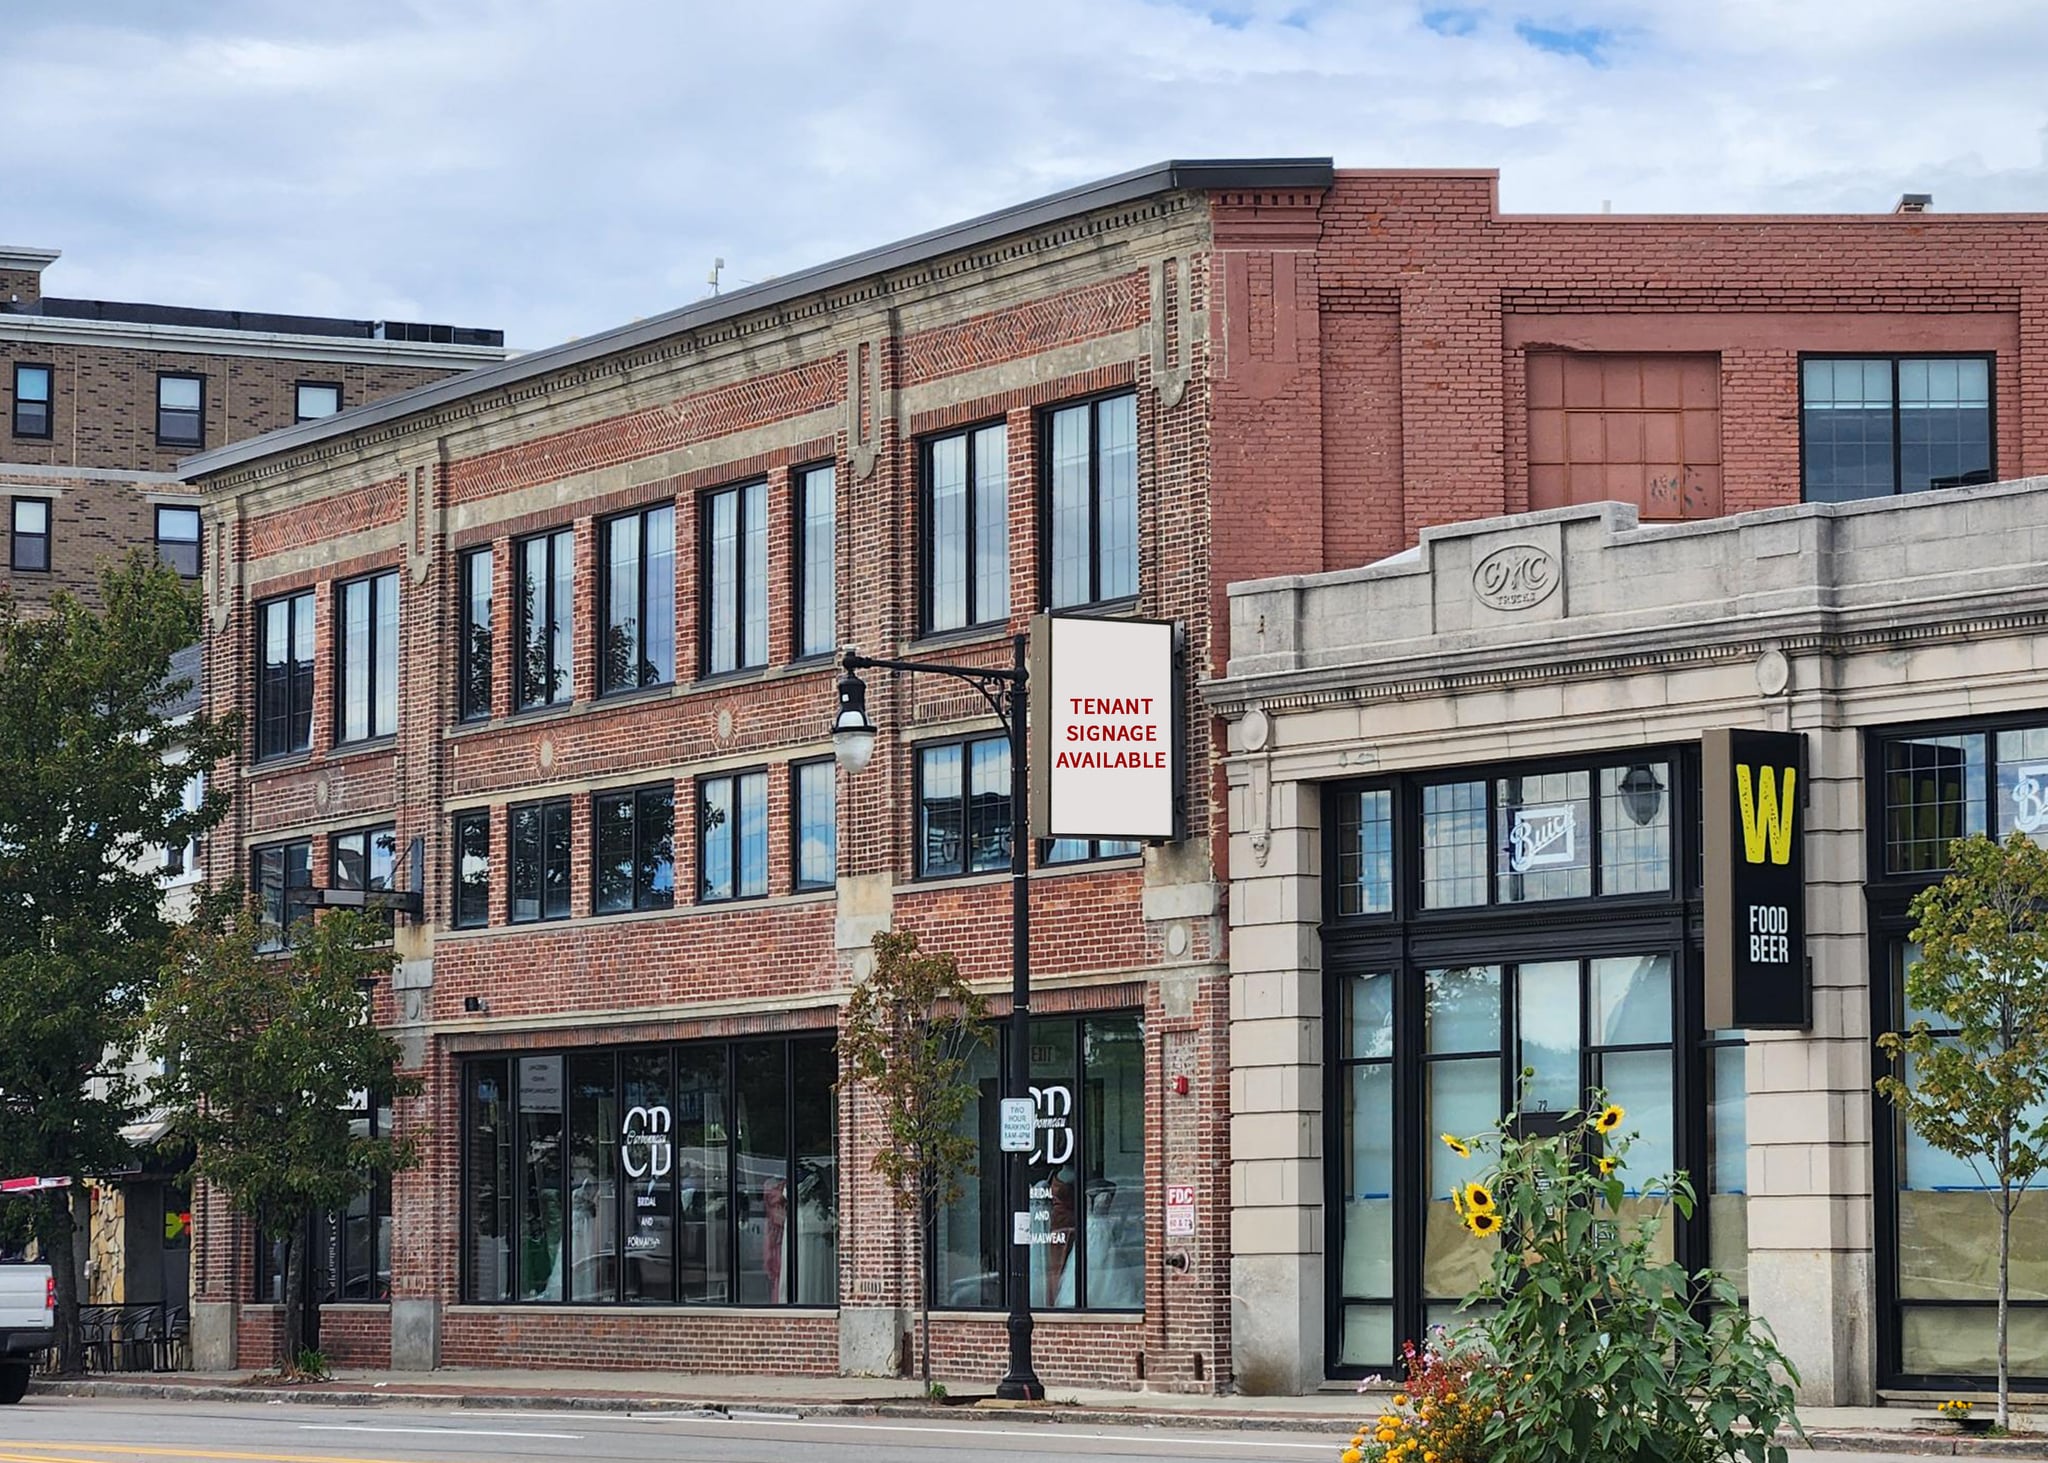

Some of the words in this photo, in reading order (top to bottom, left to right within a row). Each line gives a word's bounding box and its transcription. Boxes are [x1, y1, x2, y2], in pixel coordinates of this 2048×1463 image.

[1069, 698, 1154, 715] TENANT
[1066, 724, 1158, 742] SIGNAGE
[1055, 751, 1167, 769] AVAILABLE
[1736, 763, 1796, 865] W
[1510, 804, 1576, 872] Buick
[1750, 905, 1788, 934] FOOD
[1750, 935, 1789, 963] BEER
[1010, 1106, 1025, 1114] TWO
[1537, 1100, 1548, 1111] 72
[1008, 1114, 1027, 1123] HOUR
[1004, 1123, 1031, 1132] PARKING
[1029, 1187, 1053, 1199] BRIDAL
[1168, 1188, 1193, 1205] FDC
[637, 1196, 656, 1207] BRIDAL
[641, 1216, 654, 1226] AND
[1034, 1210, 1050, 1221] AND
